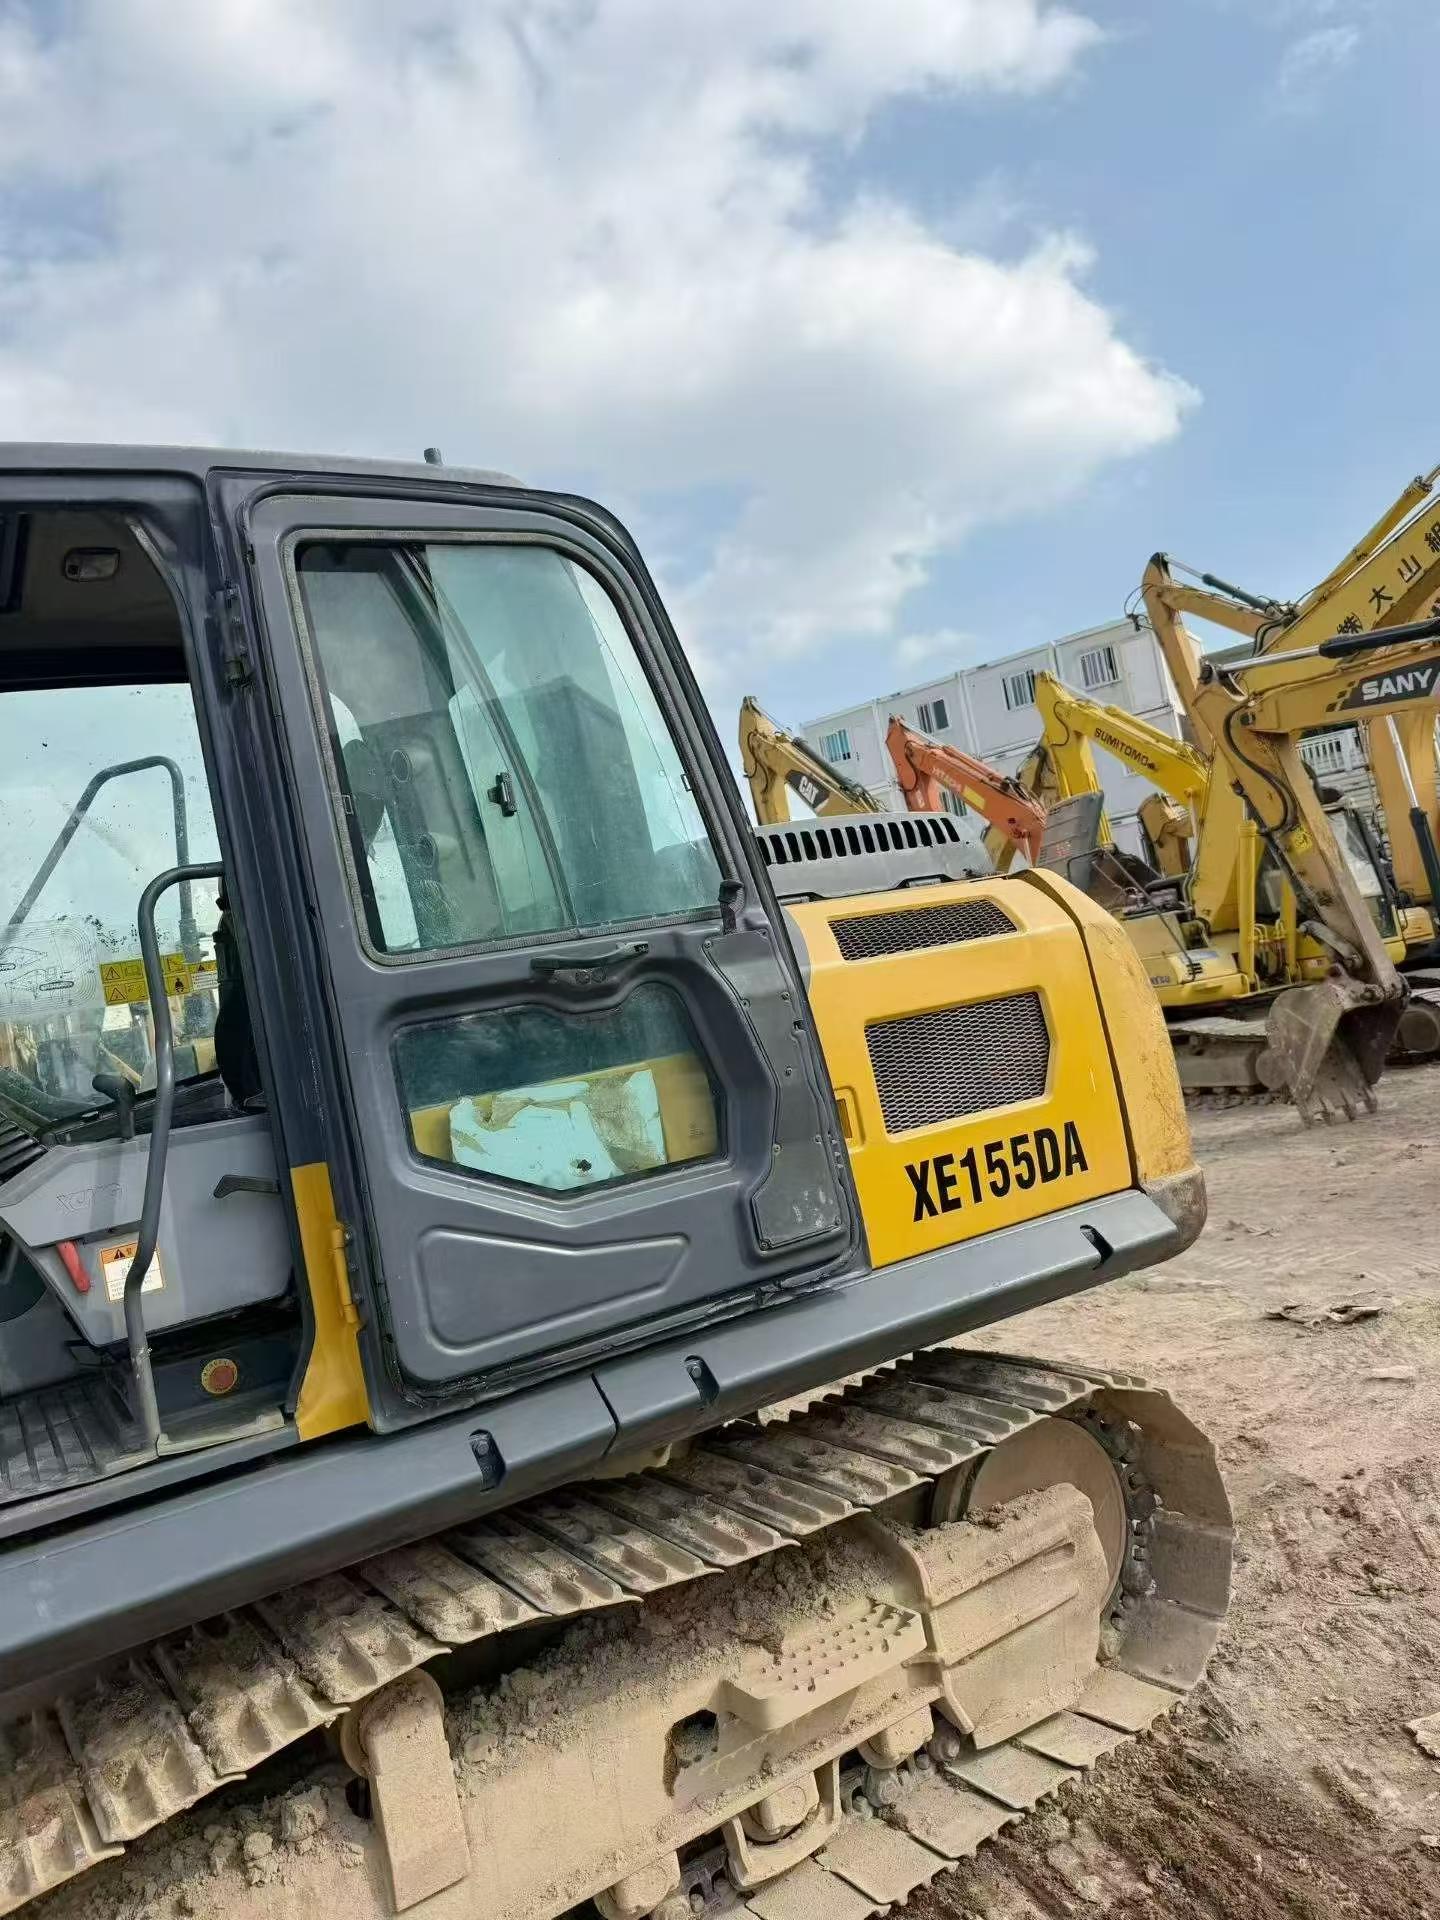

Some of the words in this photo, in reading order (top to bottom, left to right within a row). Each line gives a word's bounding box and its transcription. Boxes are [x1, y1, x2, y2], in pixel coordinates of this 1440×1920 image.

[1361, 668, 1432, 700] SANY
[1095, 727, 1149, 768] SUMITOMO
[799, 775, 819, 804] CAT
[904, 1120, 1089, 1222] XE155DA
